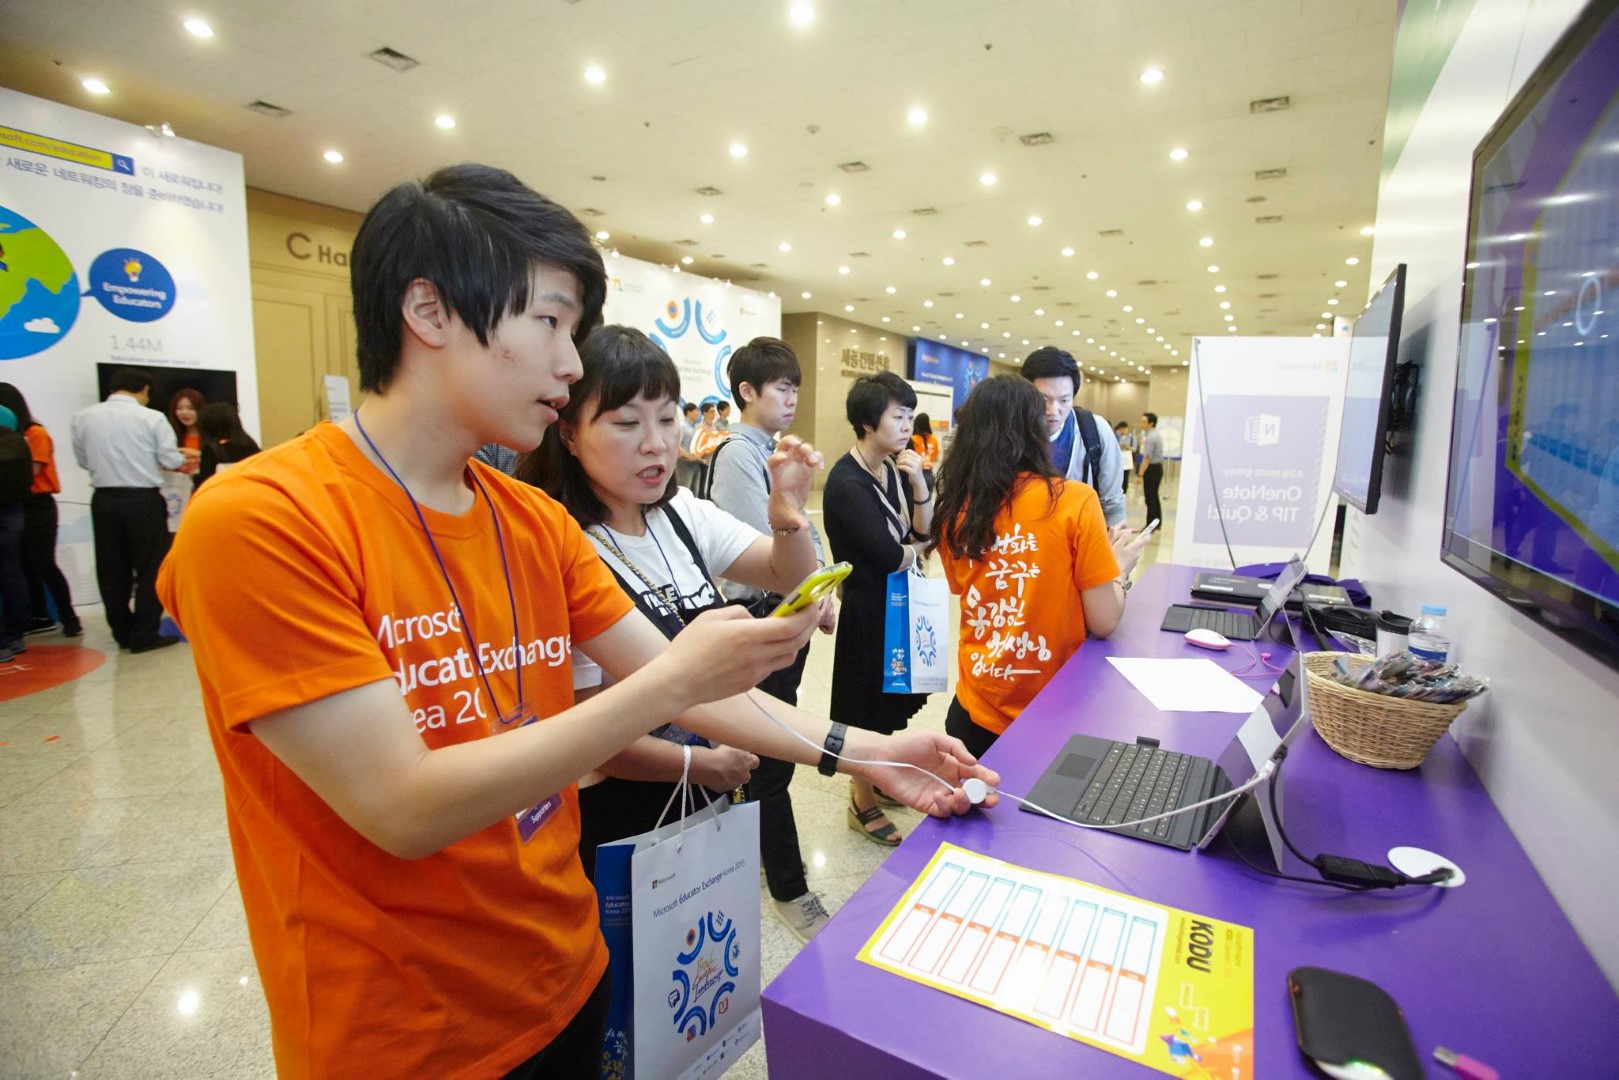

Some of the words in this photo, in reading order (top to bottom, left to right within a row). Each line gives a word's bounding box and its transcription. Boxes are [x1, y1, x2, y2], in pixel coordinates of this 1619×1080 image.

[6, 157, 49, 177] 새로운
[285, 231, 312, 260] C
[318, 244, 350, 267] Ha
[478, 634, 571, 677] Exchange
[653, 899, 678, 918] Microsoft
[679, 885, 701, 904] Educator
[701, 872, 723, 891] Exchange
[1186, 919, 1214, 974] KODU
